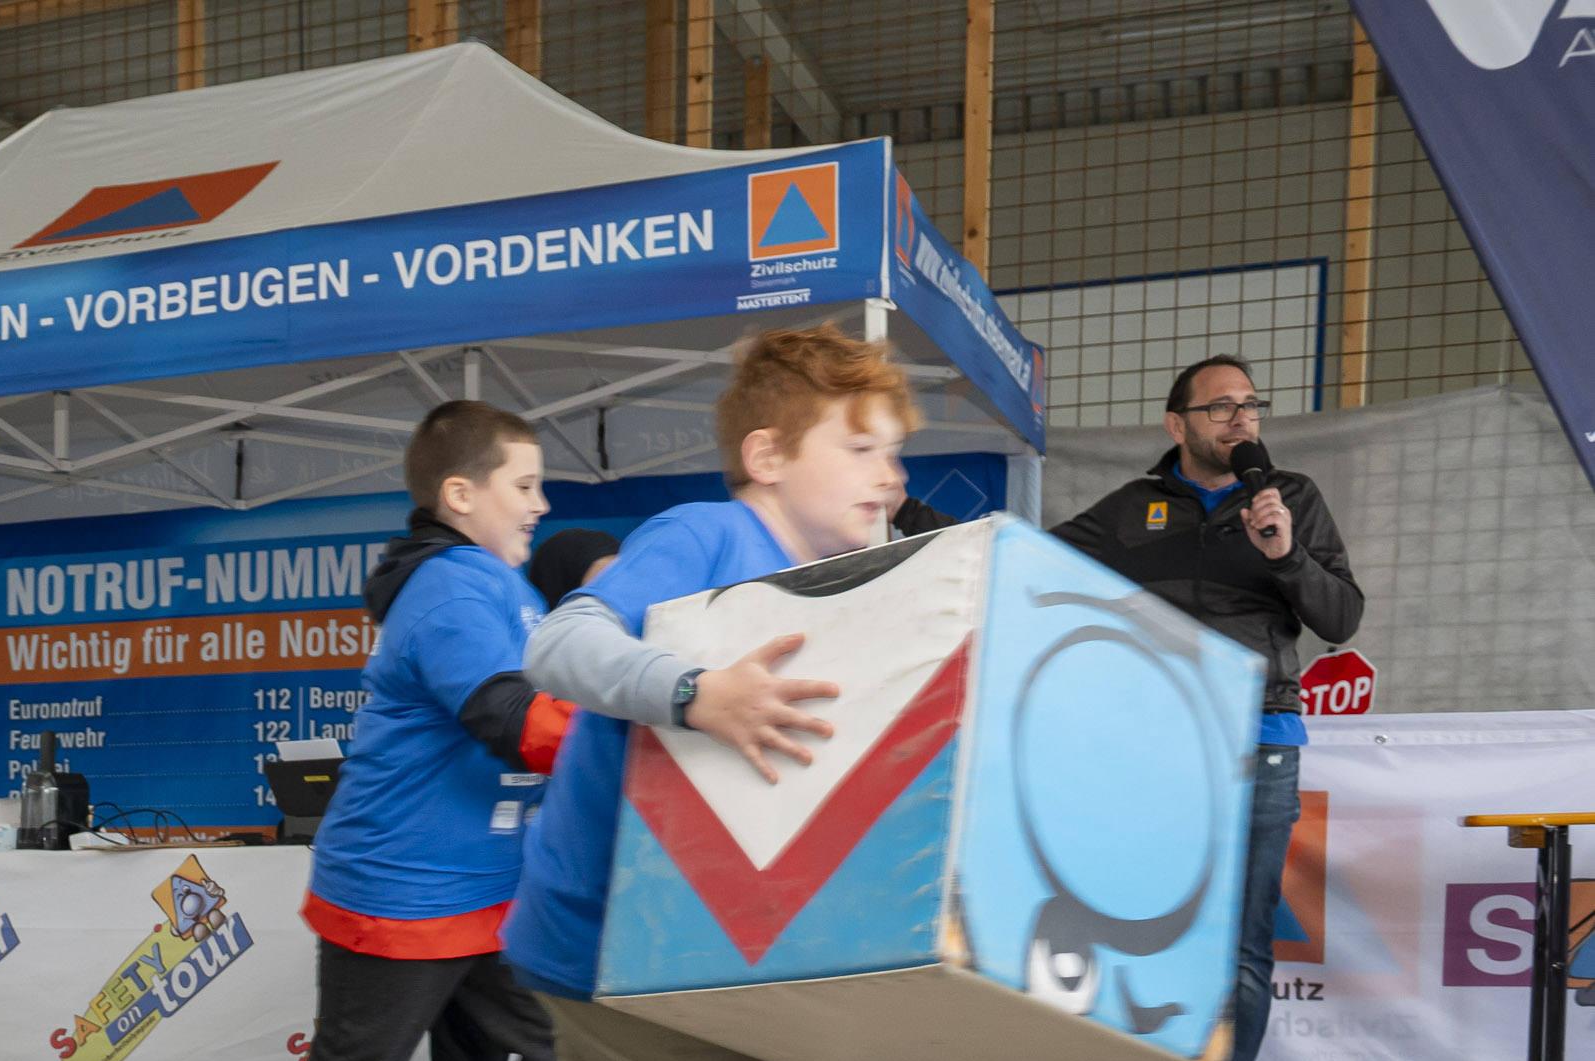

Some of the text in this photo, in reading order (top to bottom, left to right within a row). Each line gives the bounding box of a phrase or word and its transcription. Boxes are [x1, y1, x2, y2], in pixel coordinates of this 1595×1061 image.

[65, 258, 350, 332] VORBEUGEN
[392, 209, 714, 290] VORDENKEN
[750, 257, 838, 278] Zivilschutz
[736, 293, 810, 311] MASTERTENT
[7, 633, 132, 674] Wichtig
[142, 625, 189, 664] für
[200, 620, 265, 662] alle
[9, 688, 292, 720] Euronotruf 112
[253, 720, 292, 743] 122
[117, 914, 240, 1033] on tour
[50, 942, 167, 1060] SAFETY
